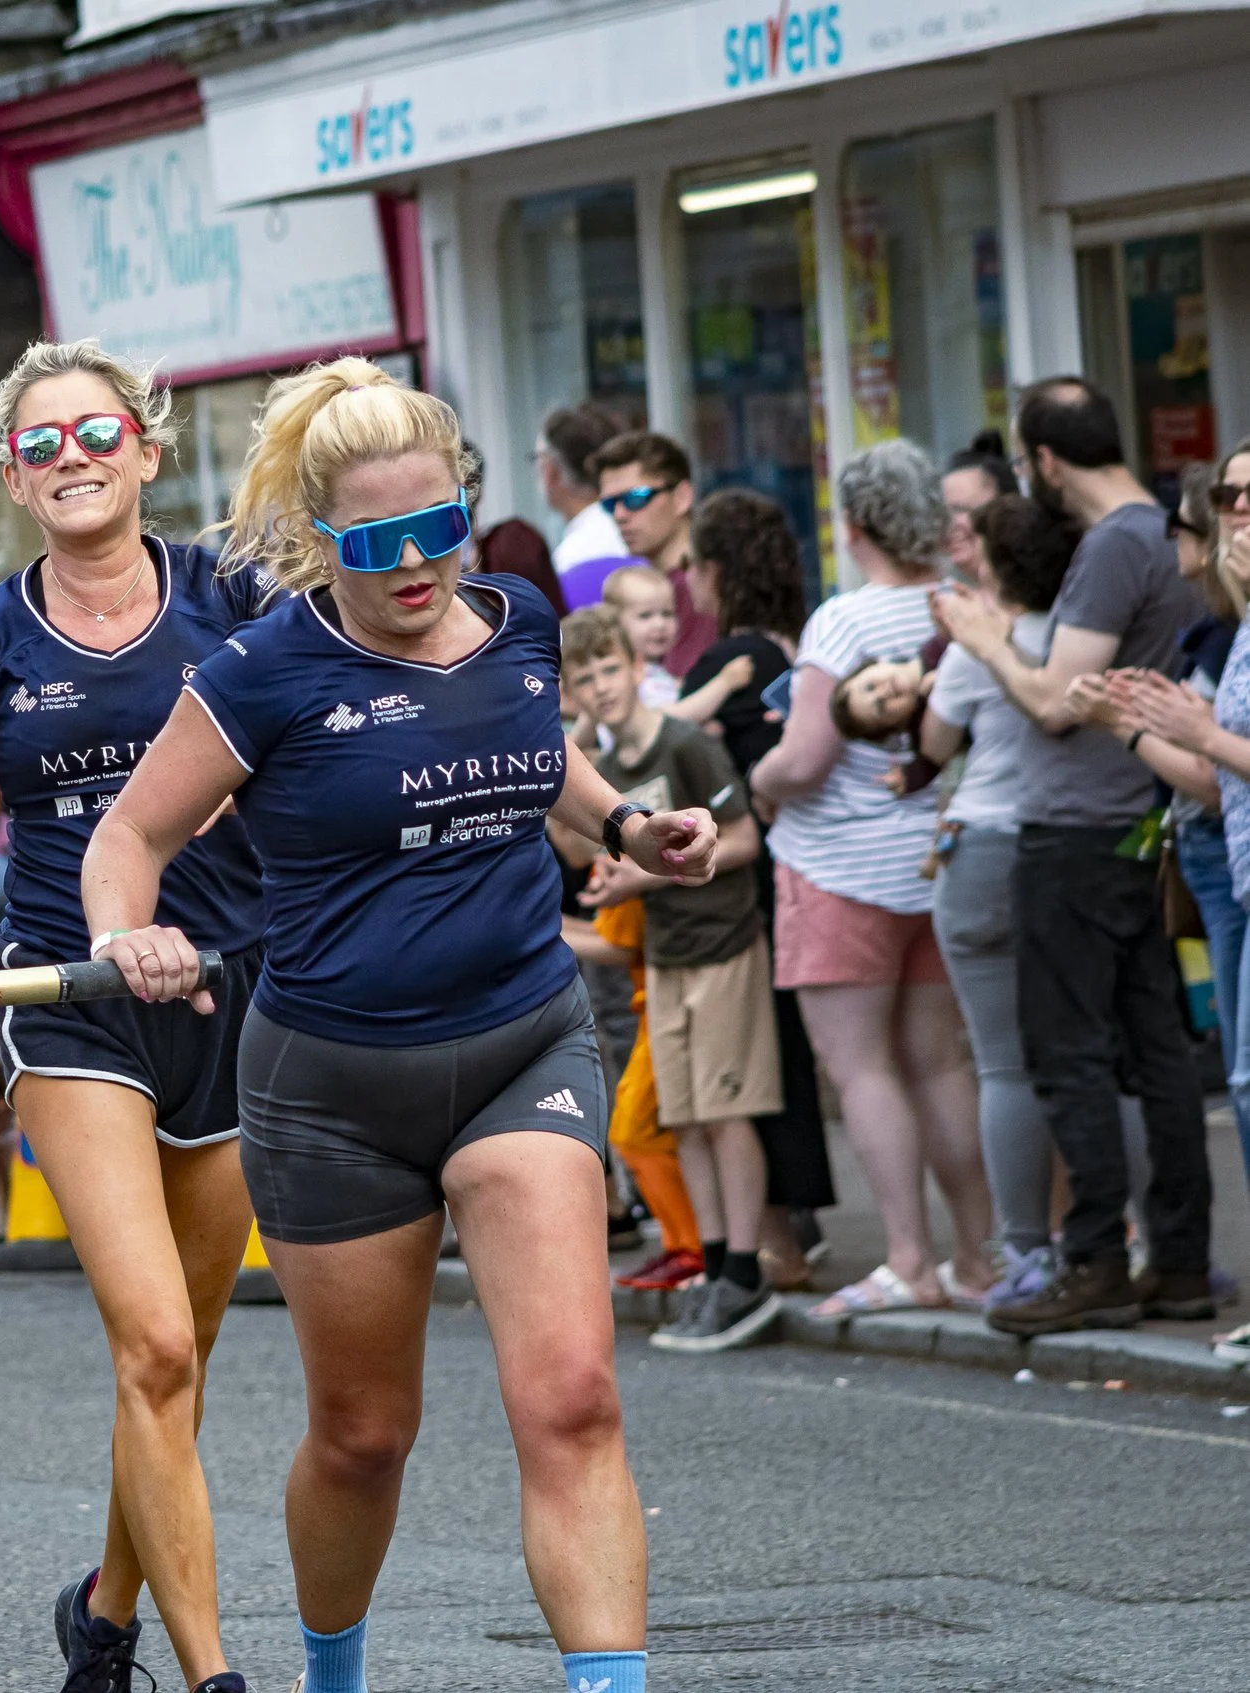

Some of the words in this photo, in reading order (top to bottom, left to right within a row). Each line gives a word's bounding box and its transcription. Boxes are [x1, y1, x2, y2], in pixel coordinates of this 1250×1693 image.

[724, 0, 843, 87] savers
[317, 82, 414, 173] savers
[40, 681, 74, 696] HSFC
[41, 695, 67, 703] Harrogate
[67, 693, 87, 701] Sports
[369, 694, 410, 711] HSFC
[372, 707, 404, 718] Harrogate
[404, 703, 426, 712] Sports
[373, 718, 380, 726] &
[381, 714, 404, 723] Fitness
[403, 711, 419, 719] Club
[40, 740, 152, 775] MYRI
[56, 774, 101, 787] Harrogate's
[102, 770, 131, 780] leading
[400, 749, 563, 794] MYRINGS
[415, 793, 463, 809] Harrogate's
[464, 787, 492, 799] leading
[493, 783, 516, 795] family
[518, 782, 539, 791] estate
[539, 782, 555, 791] agent
[450, 812, 498, 830] James
[498, 806, 549, 823] Hambro
[535, 1100, 585, 1119] adidas
